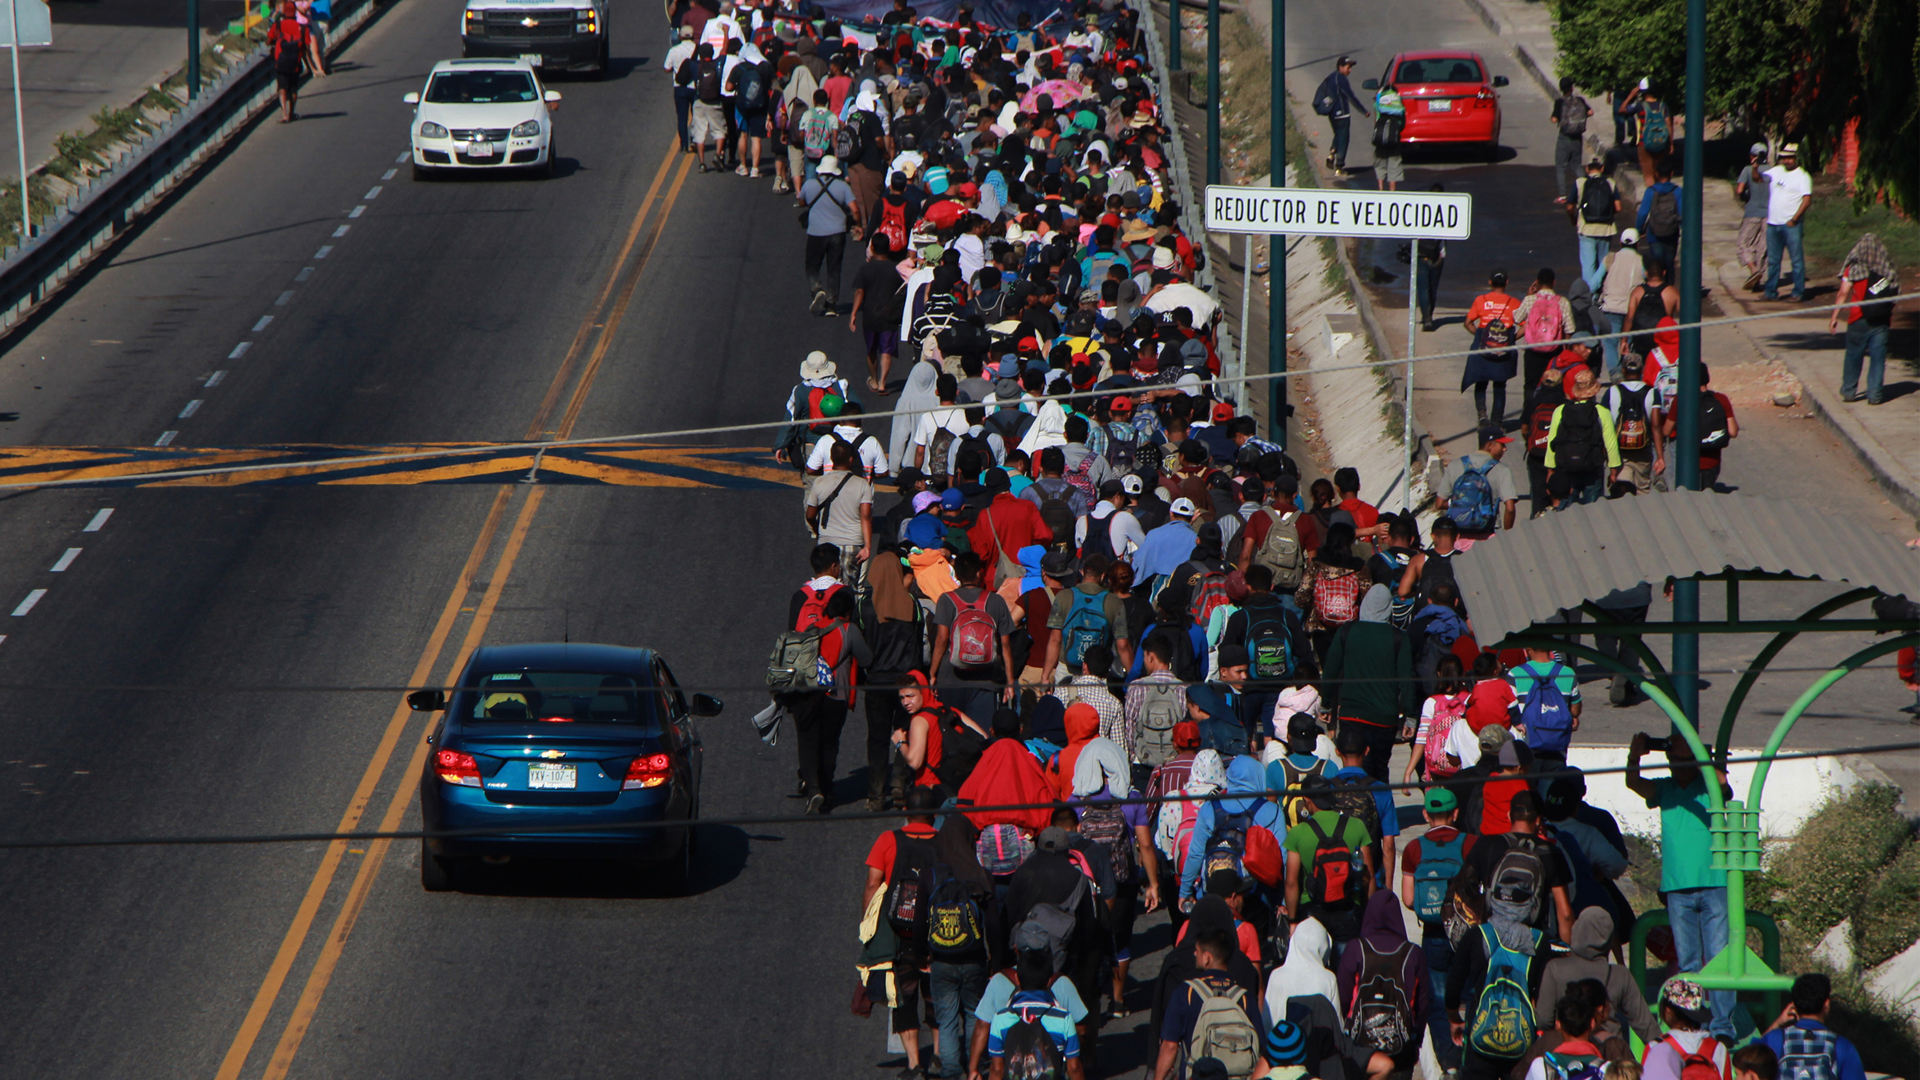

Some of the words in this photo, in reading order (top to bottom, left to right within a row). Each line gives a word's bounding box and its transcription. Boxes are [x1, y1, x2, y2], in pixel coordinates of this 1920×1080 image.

[1214, 196, 1306, 224] REDUCTOR
[1317, 200, 1340, 225] DE
[1351, 201, 1459, 228] VELOCIDAD
[530, 770, 575, 782] YXV-107-C
